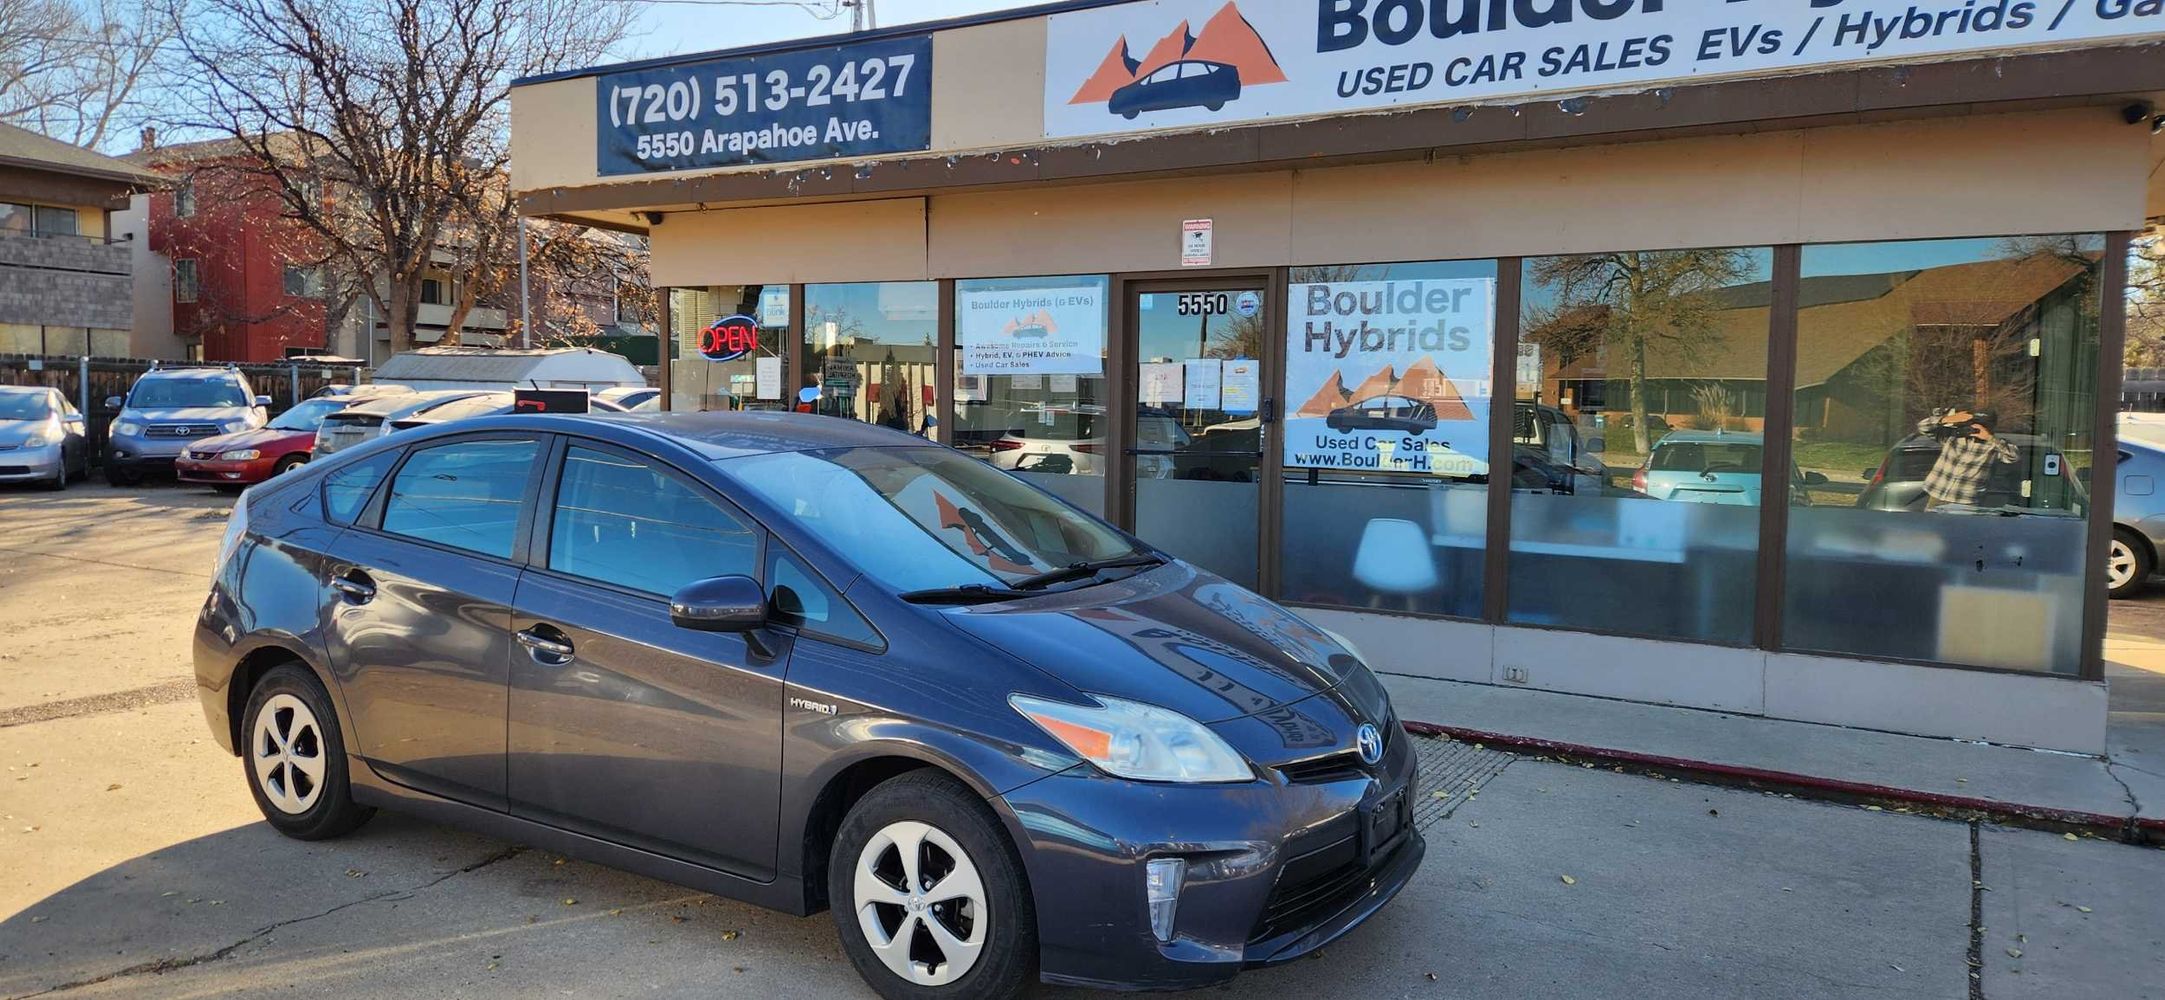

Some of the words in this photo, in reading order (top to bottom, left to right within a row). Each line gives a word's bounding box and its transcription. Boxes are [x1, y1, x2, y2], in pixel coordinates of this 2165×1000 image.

[1316, 0, 1664, 53] Boul
[1336, 62, 1434, 98] USED
[1445, 51, 1527, 87] CAR
[1538, 34, 1674, 77] SALES
[1696, 24, 1783, 62] EVs
[1793, 16, 1824, 56] /
[1833, 0, 2036, 50] Hybrids
[610, 75, 701, 128] (720)
[714, 54, 915, 117] 513-2427
[636, 131, 695, 160] 5550
[700, 123, 817, 155] Arapahoe
[823, 117, 879, 144] Ave.
[971, 299, 1009, 310] Boulder
[1013, 297, 1052, 309] Hybrids
[1068, 296, 1094, 307] EVs)
[1178, 293, 1228, 316] 5550
[1306, 282, 1473, 317] Boulder
[697, 325, 758, 352] OPEN
[1045, 350, 1071, 358] Advice
[1304, 319, 1472, 359] Hybrids
[1316, 435, 1359, 450] Used
[1402, 437, 1451, 451] Sales
[790, 698, 830, 714] HYBRID
